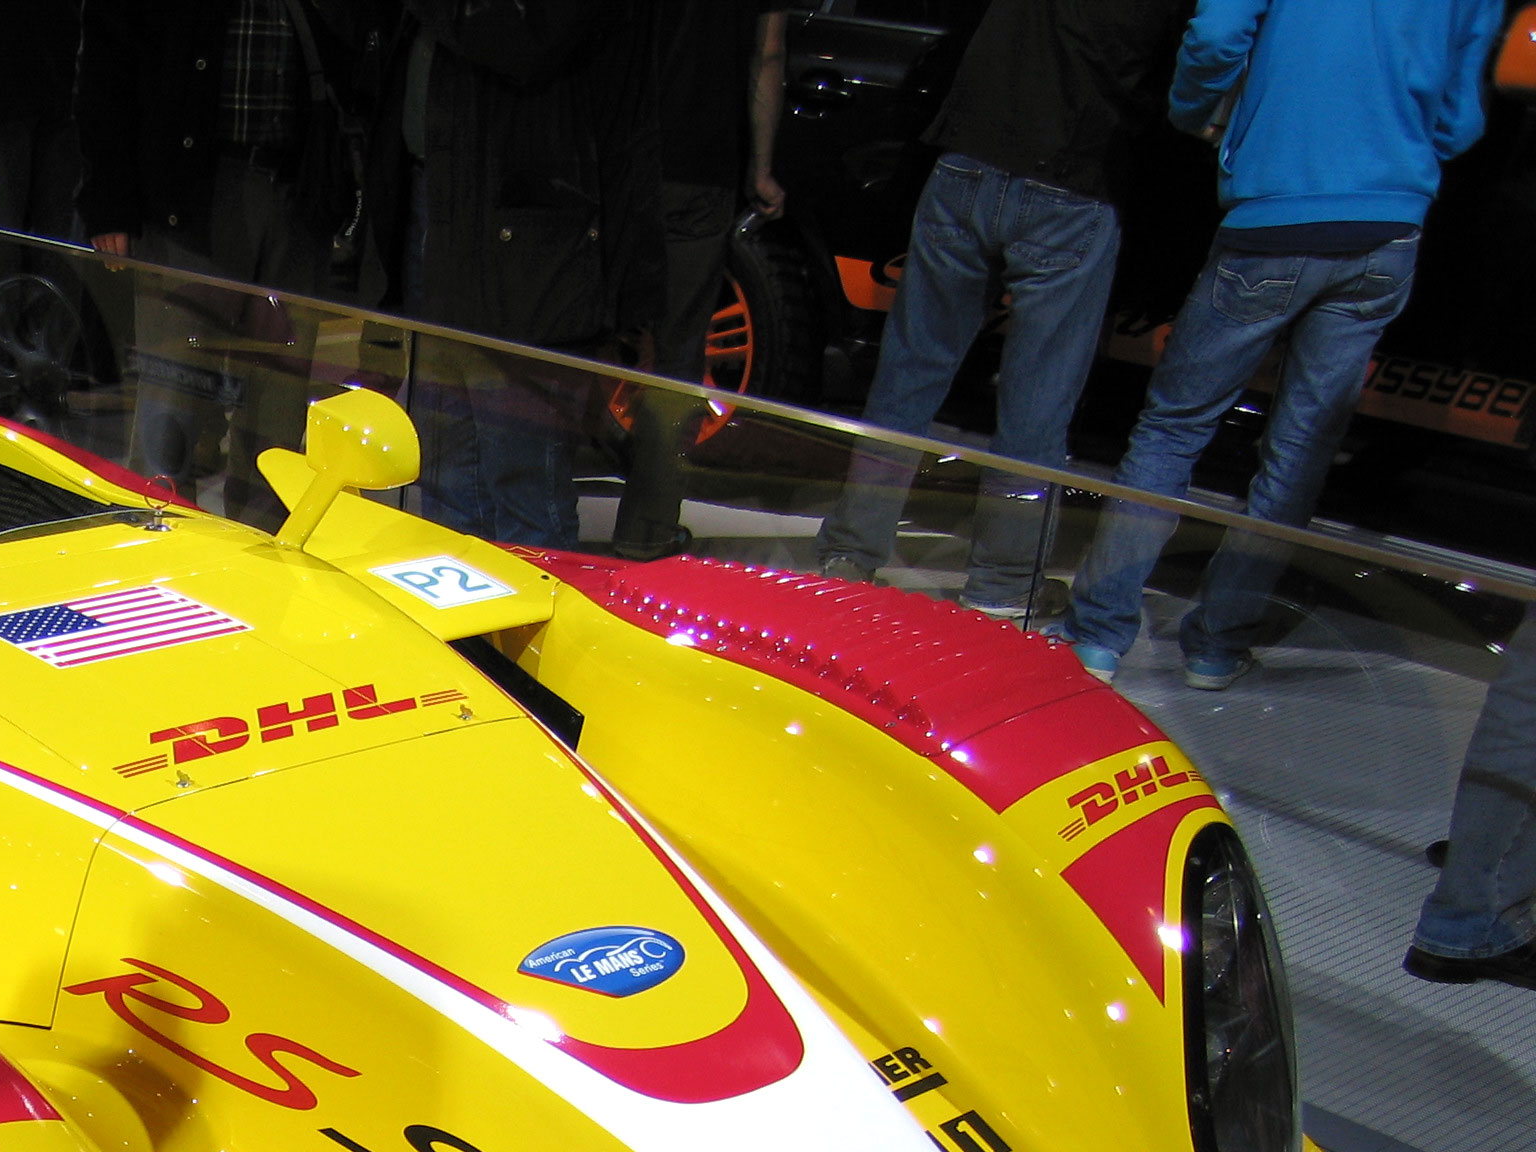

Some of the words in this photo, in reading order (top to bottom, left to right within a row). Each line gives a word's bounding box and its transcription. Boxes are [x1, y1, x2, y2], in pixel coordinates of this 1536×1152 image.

[392, 566, 493, 599] P2
[150, 684, 417, 764] DHL
[1067, 756, 1190, 826] DHL
[527, 947, 577, 969] American
[570, 963, 597, 983] LE
[592, 950, 644, 976] MANS
[629, 961, 664, 977] Series
[61, 957, 362, 1111] RS
